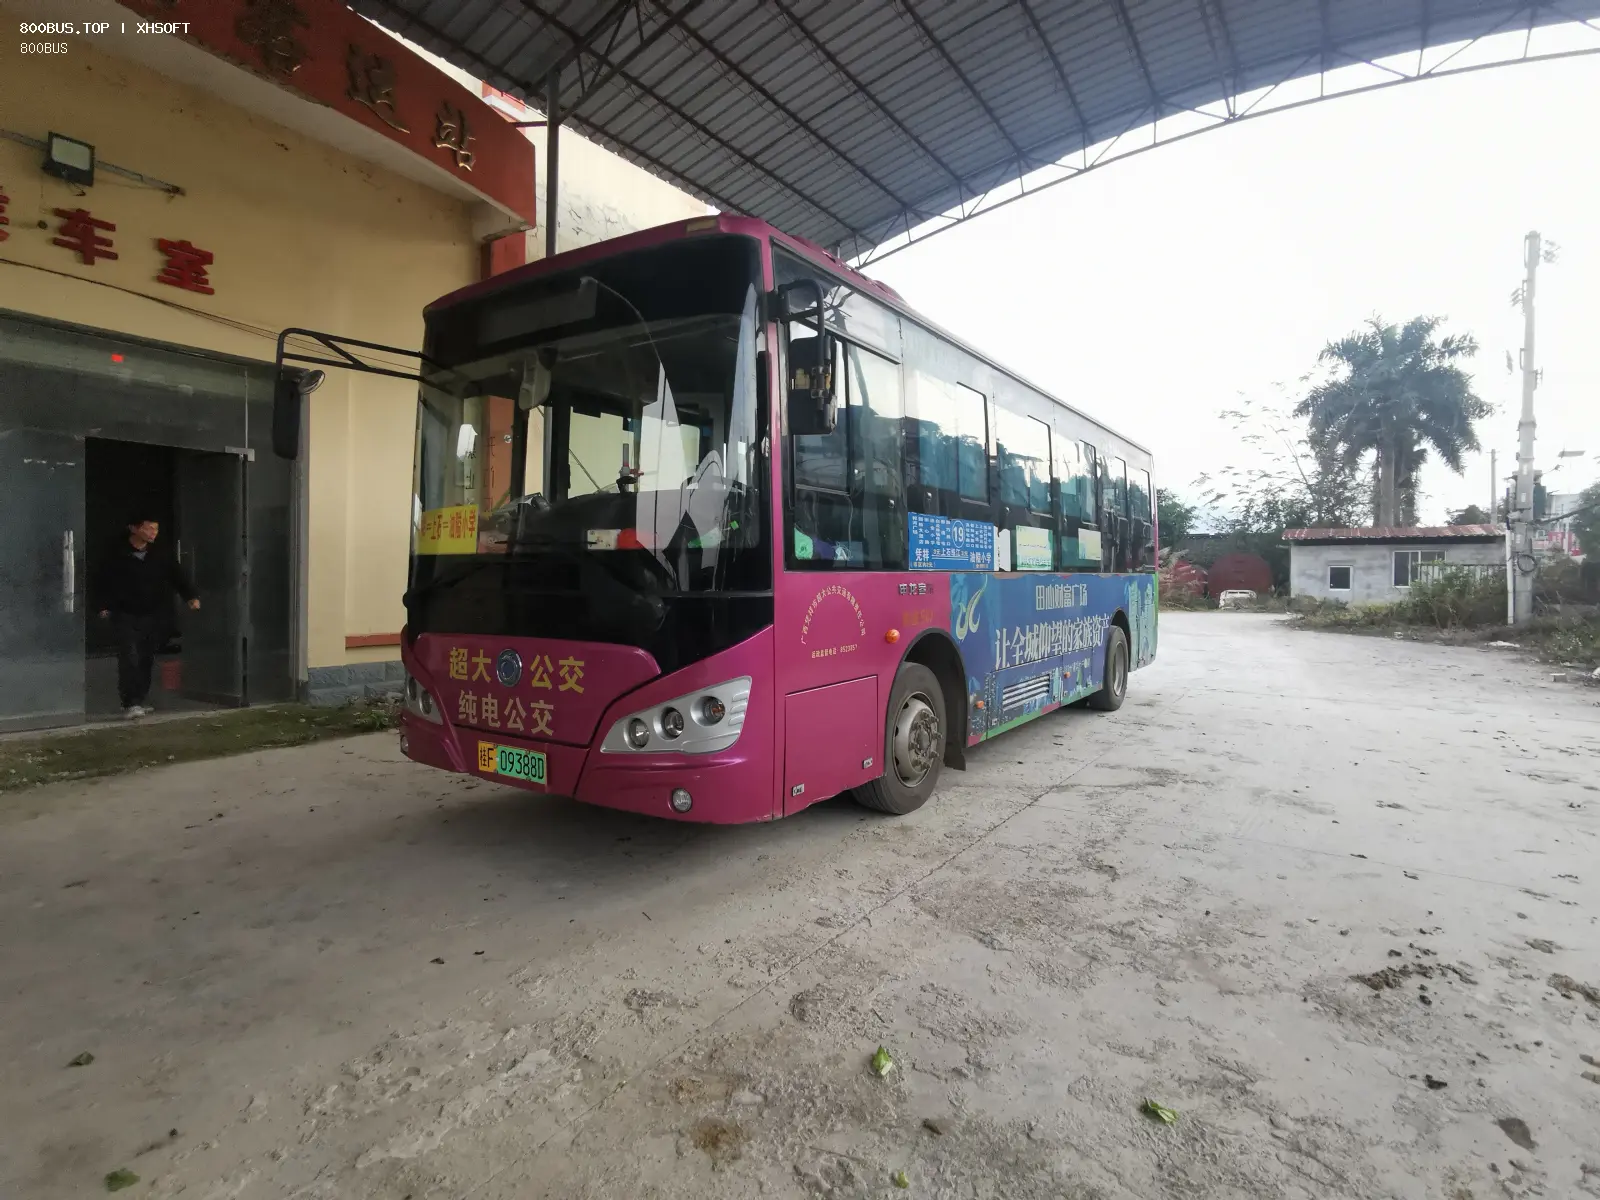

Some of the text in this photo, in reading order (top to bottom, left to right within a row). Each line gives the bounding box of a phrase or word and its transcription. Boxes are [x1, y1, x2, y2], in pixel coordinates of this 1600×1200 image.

[0, 186, 215, 296] 车室
[953, 525, 964, 543] 19
[448, 646, 586, 694] 超大 公交
[458, 688, 555, 737] 纯电公交
[499, 749, 545, 780] 09388D
